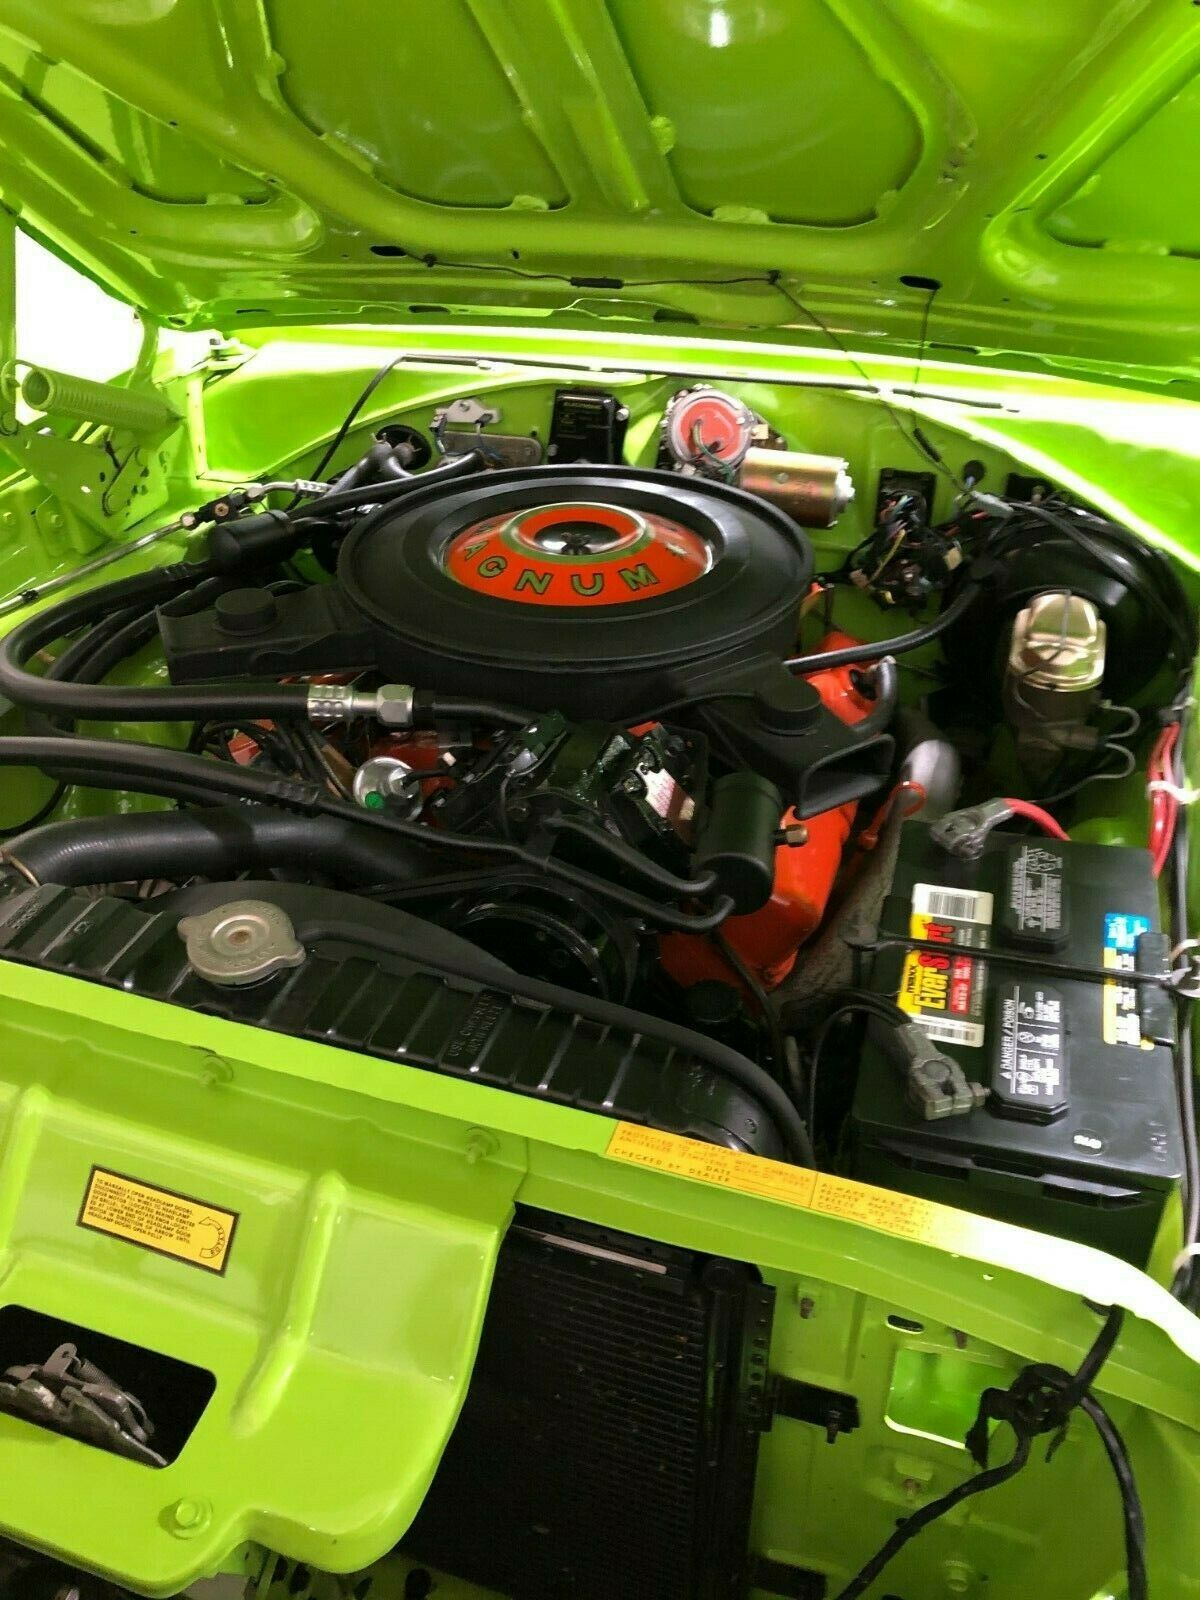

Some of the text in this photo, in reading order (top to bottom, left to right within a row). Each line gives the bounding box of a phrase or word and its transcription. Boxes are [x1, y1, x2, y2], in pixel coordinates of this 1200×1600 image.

[914, 922, 953, 1010] EverSrt
[1000, 998, 1015, 1028] POISON
[1000, 1035, 1015, 1069] DANGER
[613, 1148, 730, 1183] CHECKED BY DEALER
[705, 1165, 731, 1176] DATE
[92, 1189, 107, 1197] DOOR
[108, 1194, 126, 1204] MOTOR
[155, 1210, 174, 1220] BEHIND
[175, 1216, 195, 1227] CENTER
[103, 1181, 130, 1193] MANUALLY
[131, 1190, 144, 1198] OPEN
[146, 1195, 173, 1208] HEADLAMP
[137, 1197, 152, 1206] WIRES
[162, 1206, 189, 1219] HEADLAMP
[87, 1210, 113, 1223] HEADLAMP
[114, 1219, 131, 1229] DOORS
[132, 1225, 146, 1234] OPEN
[88, 1205, 106, 1215] MOTOR
[115, 1214, 143, 1227] DIRECTION
[154, 1227, 173, 1238] ARROW
[106, 1205, 123, 1215] LOWER
[146, 1218, 174, 1232] HEADLAMP
[175, 1228, 190, 1238] DOOR
[155, 1216, 169, 1224] KNOB
